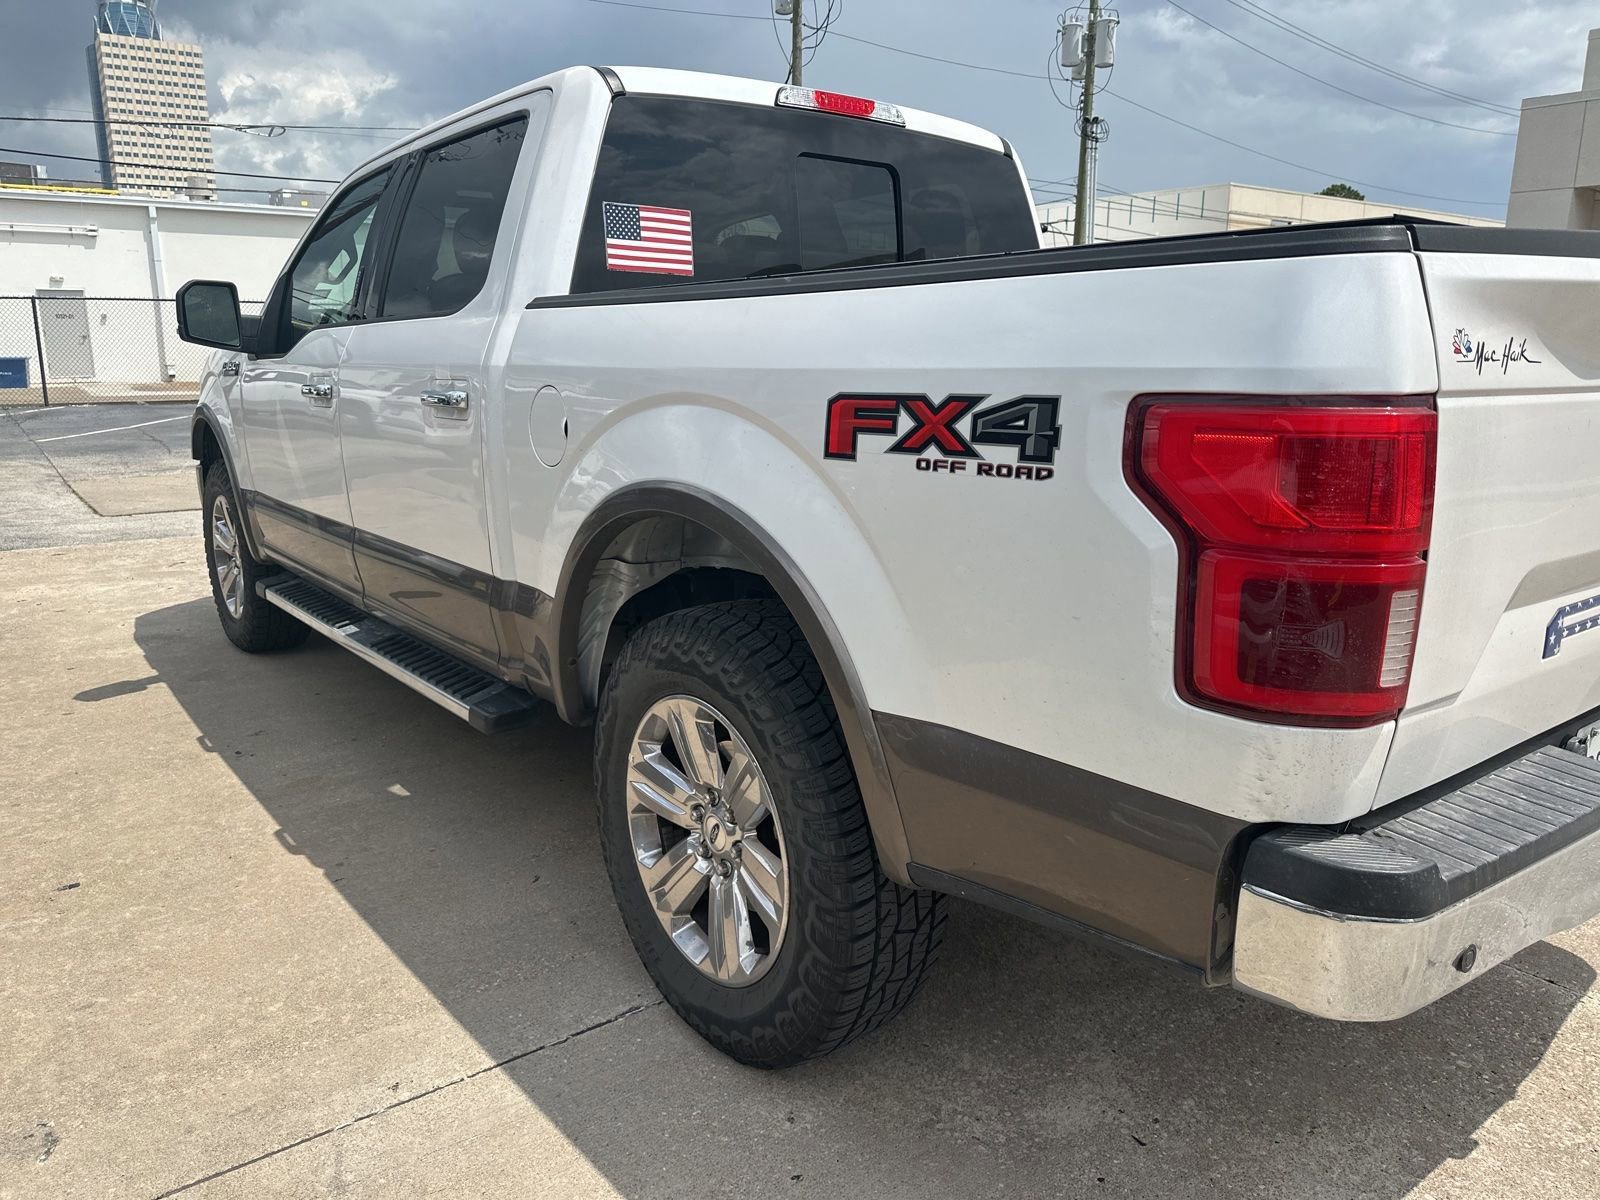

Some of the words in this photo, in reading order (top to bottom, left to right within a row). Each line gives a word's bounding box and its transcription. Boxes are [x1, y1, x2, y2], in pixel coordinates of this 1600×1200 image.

[1456, 341, 1501, 376] Mac
[824, 392, 1062, 465] FX4
[915, 457, 967, 474] OFF
[976, 462, 1055, 481] ROAD
